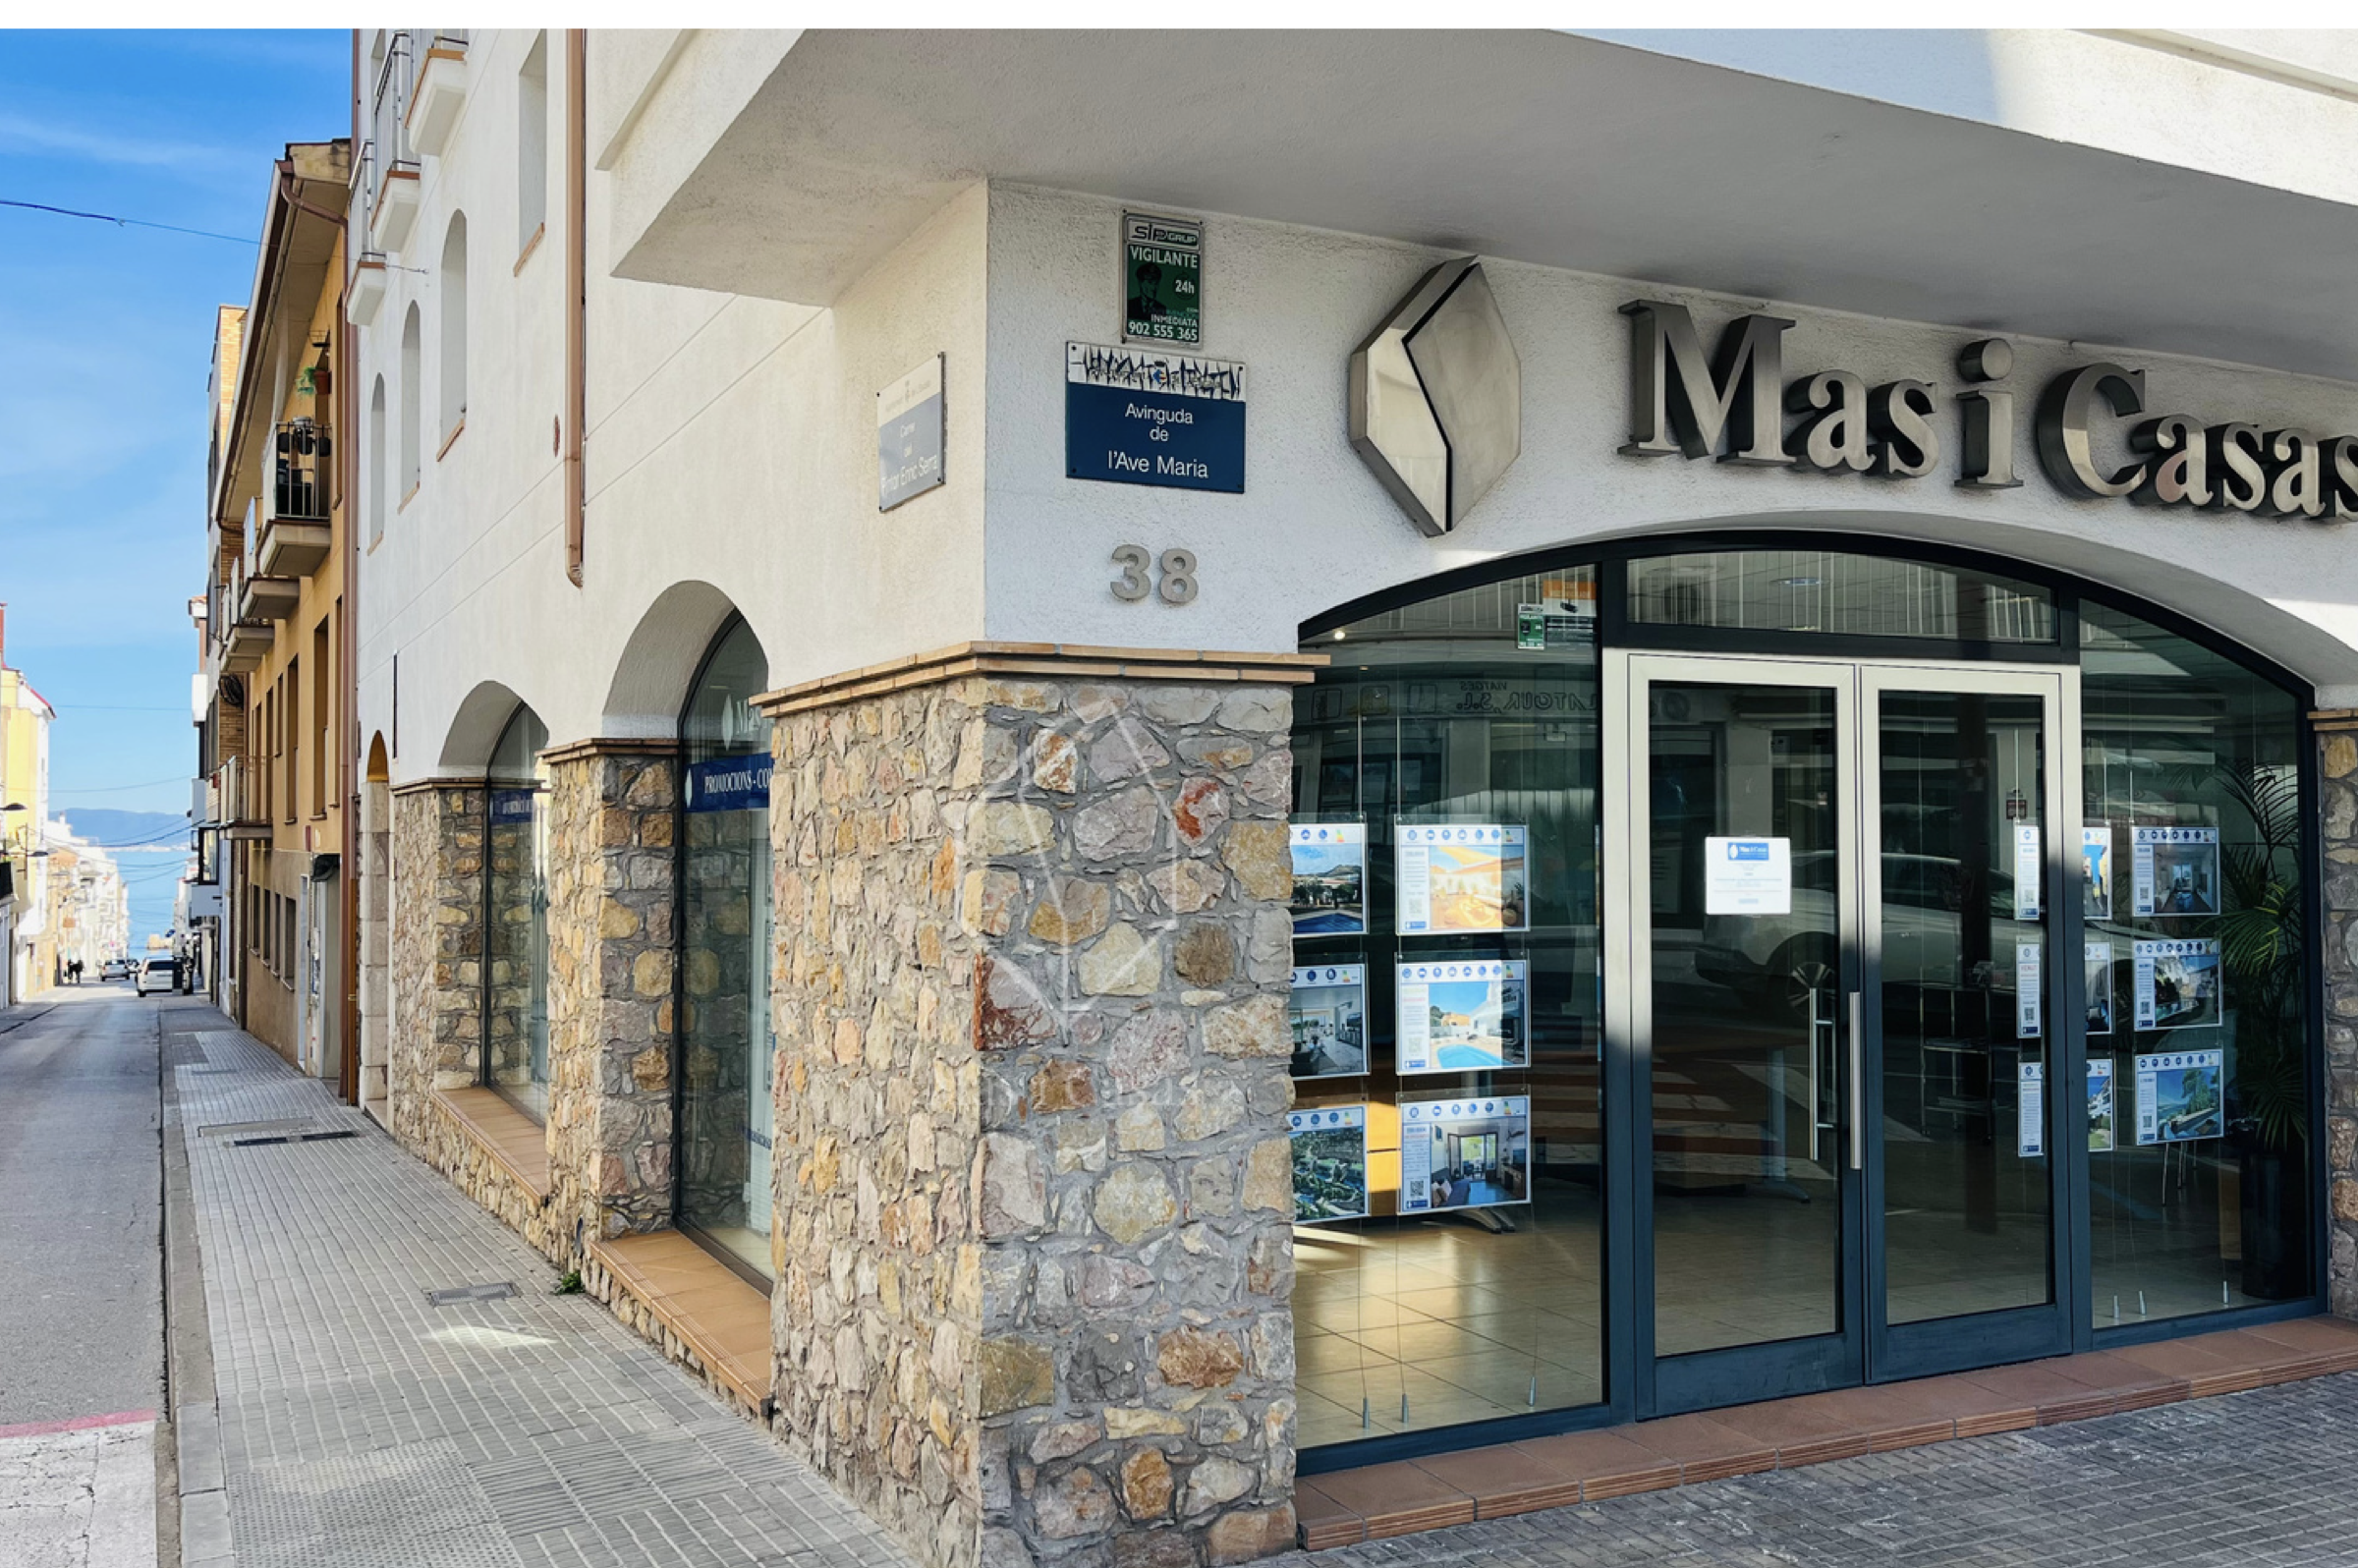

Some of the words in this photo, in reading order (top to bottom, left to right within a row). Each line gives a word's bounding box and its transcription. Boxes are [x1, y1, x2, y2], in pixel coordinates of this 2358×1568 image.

[1129, 245, 1199, 268] VIGILANTE
[1175, 279, 1195, 294] 24h
[1128, 321, 1151, 335] 902
[1153, 324, 1174, 338] 555
[1176, 326, 1198, 341] 365
[1151, 313, 1198, 328] INMEDIATA
[1124, 403, 1194, 424] Avinguda
[1618, 299, 1940, 478] Mas
[2036, 362, 2358, 524] Casas
[1149, 425, 1169, 442] de
[1107, 449, 1150, 473] l'Ave
[1156, 454, 1209, 478] Maria
[1110, 543, 1200, 605] 38
